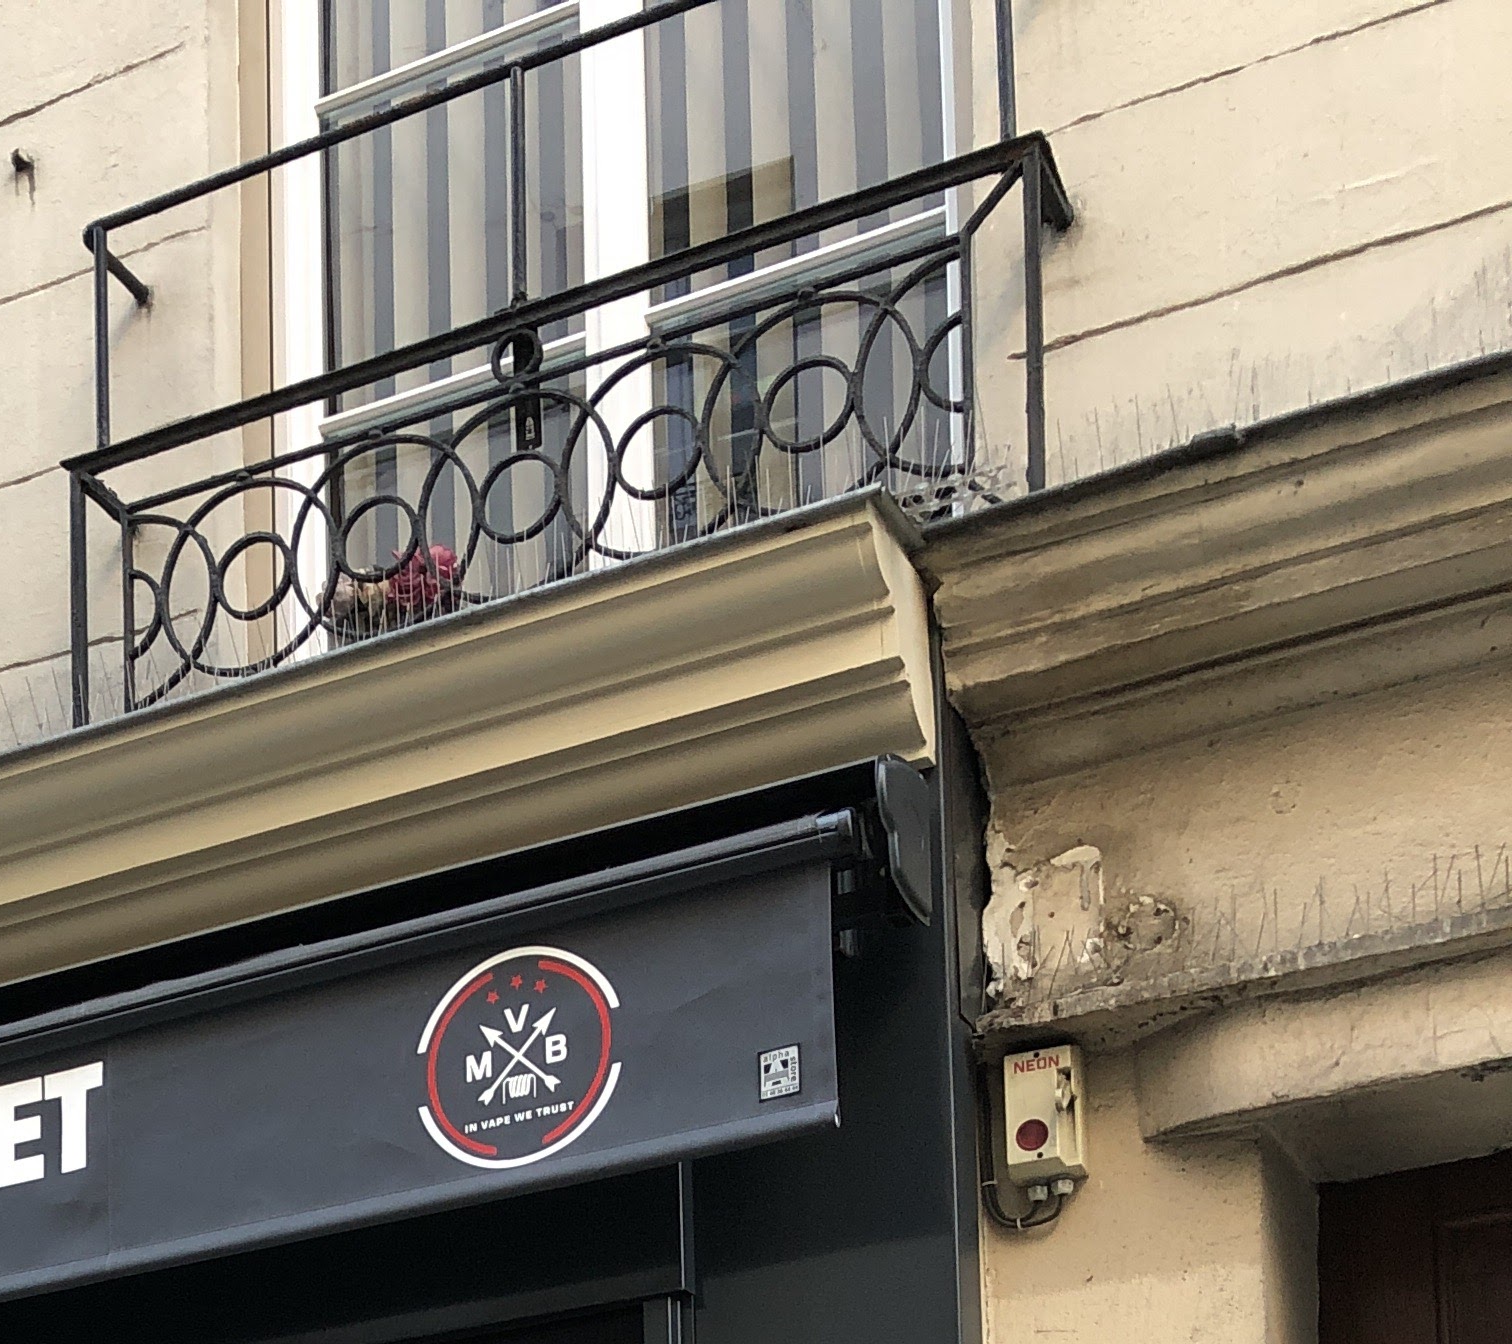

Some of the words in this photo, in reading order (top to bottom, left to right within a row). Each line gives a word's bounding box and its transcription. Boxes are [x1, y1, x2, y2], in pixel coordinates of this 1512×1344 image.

[763, 1051, 790, 1063] alpha
[1013, 1054, 1061, 1074] NEON
[464, 1122, 478, 1135] IN
[481, 1115, 511, 1130] VAPE
[514, 1110, 533, 1123] WE
[536, 1101, 575, 1118] TRUST
